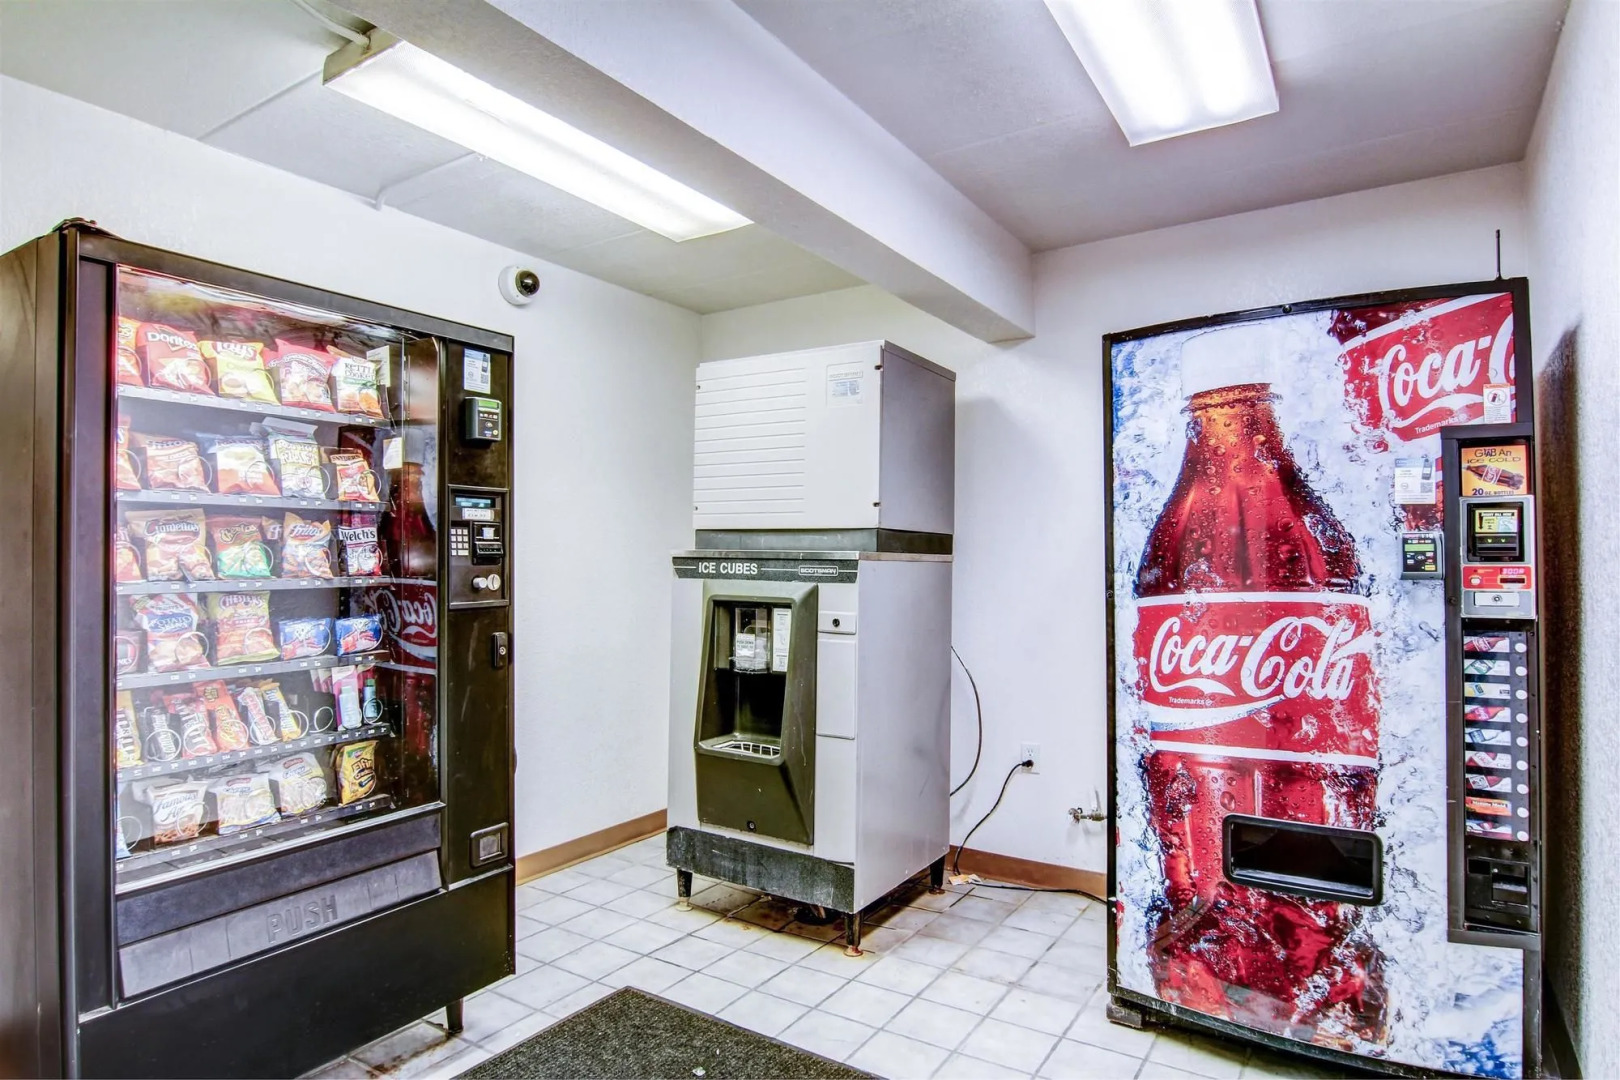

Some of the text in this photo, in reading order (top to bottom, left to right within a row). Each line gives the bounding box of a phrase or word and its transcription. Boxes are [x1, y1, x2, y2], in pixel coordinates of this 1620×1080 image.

[340, 529, 376, 541] Welch's
[698, 562, 758, 575] ICE CUBES
[1150, 616, 1359, 700] Coca-Cola
[266, 894, 339, 944] PUSH
